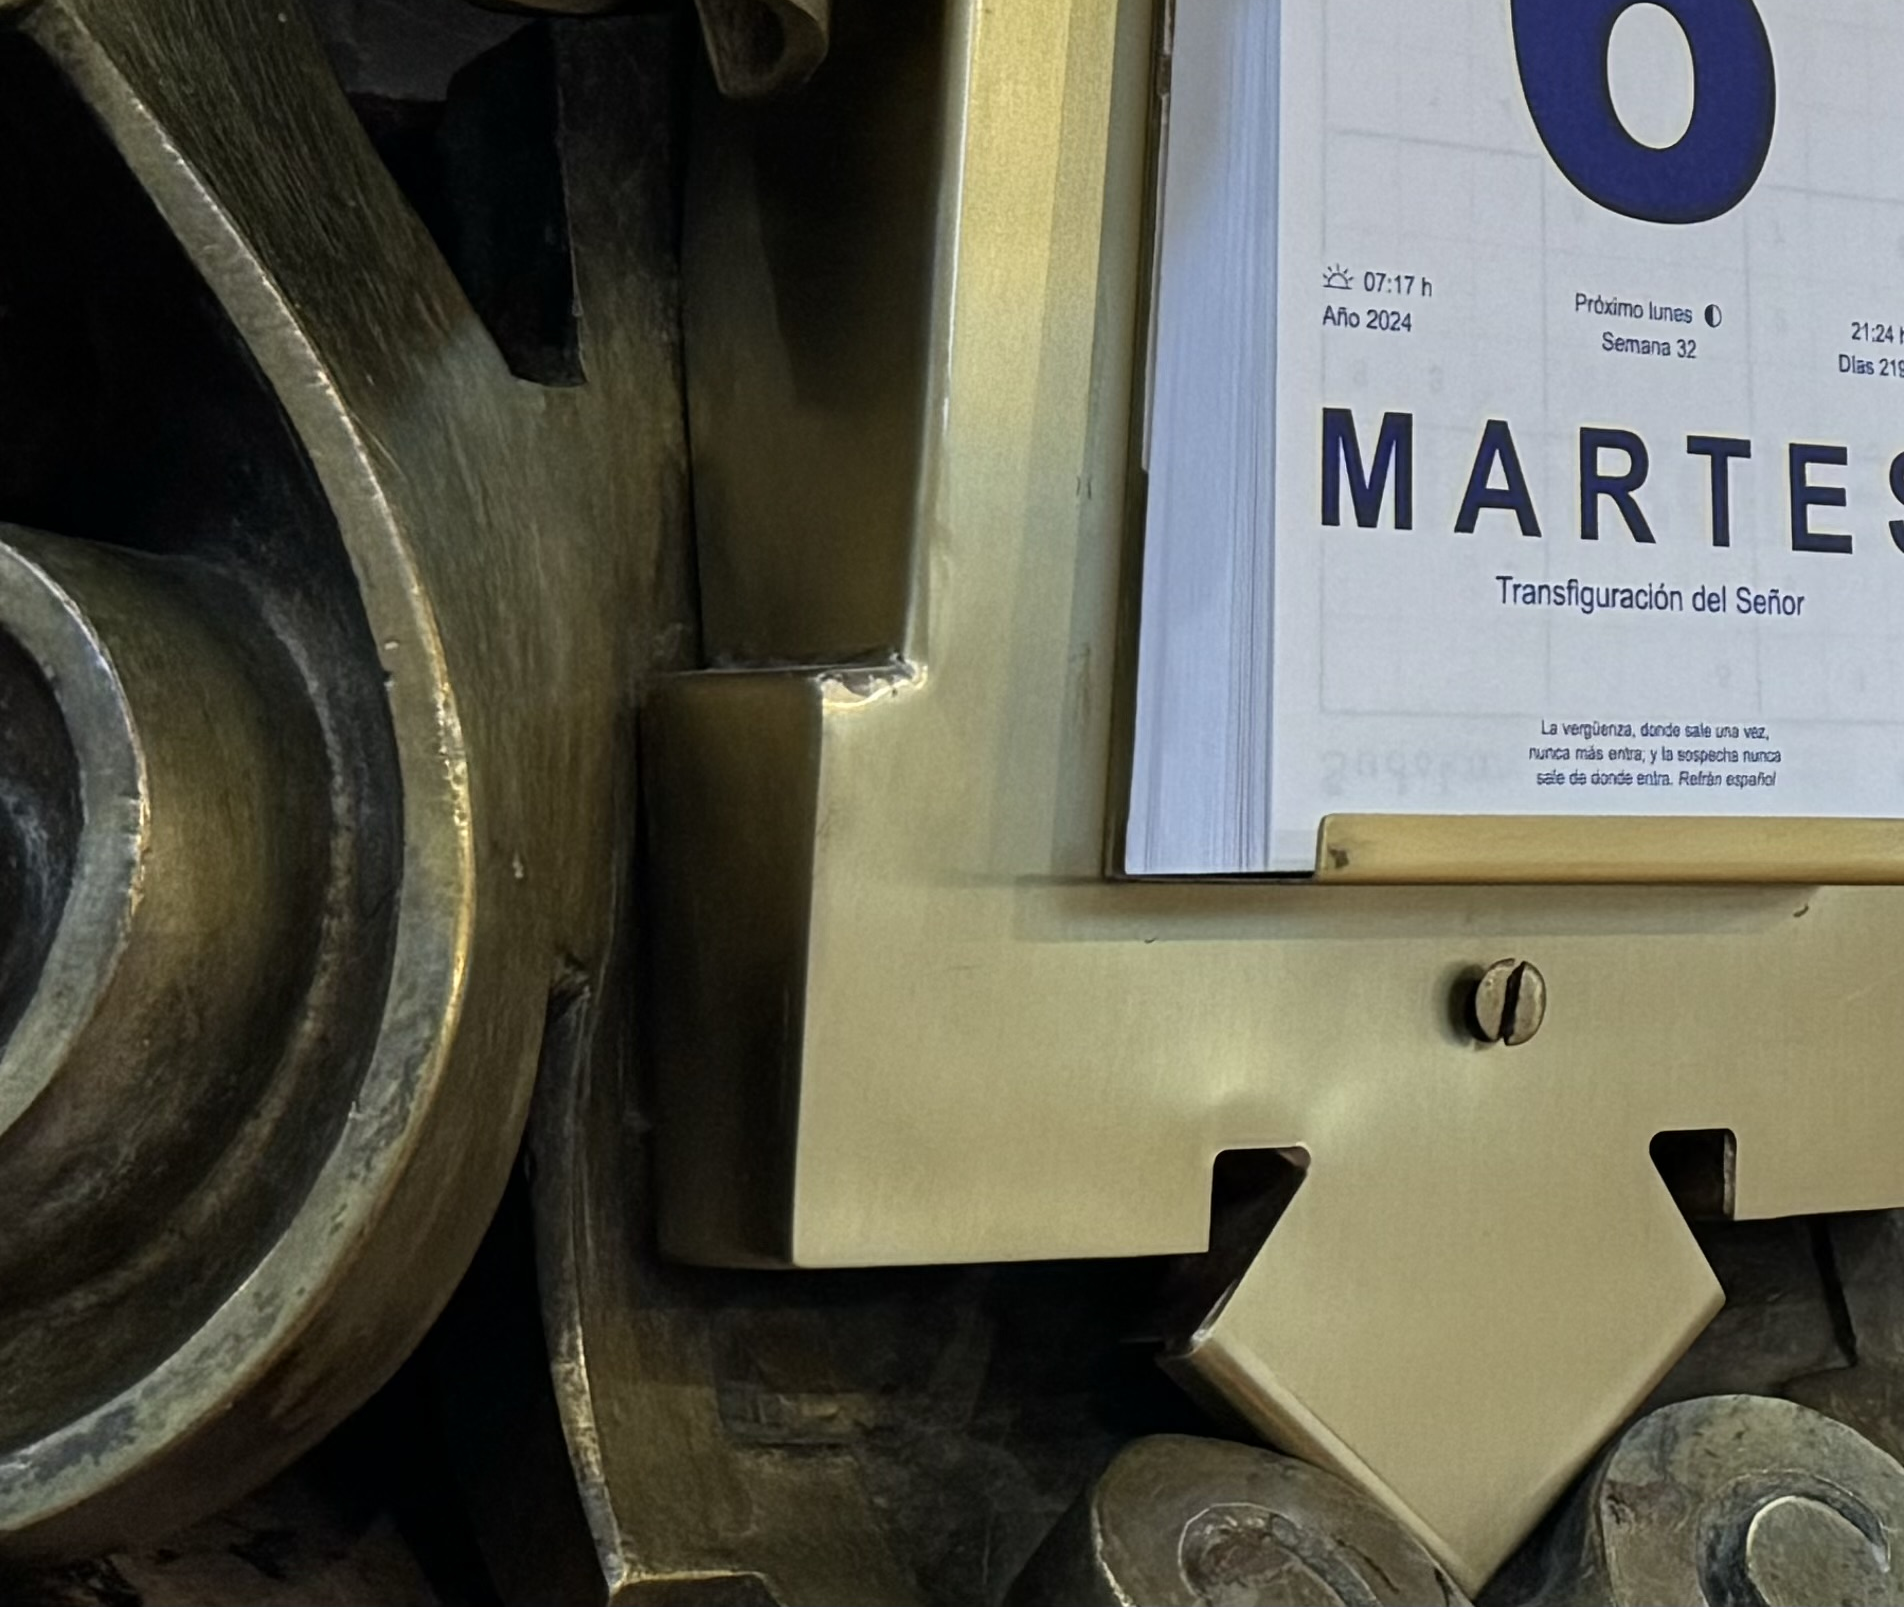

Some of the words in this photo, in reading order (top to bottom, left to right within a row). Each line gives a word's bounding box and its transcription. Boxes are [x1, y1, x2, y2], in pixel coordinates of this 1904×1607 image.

[1363, 271, 1416, 295] 07:17
[1422, 276, 1432, 297] h
[1322, 305, 1360, 328] Año
[1366, 309, 1413, 332] 2024
[1575, 292, 1643, 319] Próximo
[1650, 300, 1693, 324] lunes
[1601, 331, 1671, 357] Semana
[1676, 338, 1697, 359] 32
[1850, 321, 1894, 344] 21:24
[1496, 575, 1683, 614] Transfiguración
[1692, 584, 1726, 613] del
[1735, 586, 1805, 616] Señor
[1541, 720, 1557, 735] La
[1640, 721, 1681, 738] donde
[1684, 721, 1712, 738] sale
[1715, 725, 1739, 739] una
[1743, 726, 1770, 741] vez,
[1528, 746, 1570, 761] nunca
[1575, 744, 1604, 761] más
[1650, 748, 1658, 765] y
[1662, 745, 1673, 761] la
[1677, 746, 1739, 764] sospecha
[1743, 749, 1782, 764] nunca
[1536, 769, 1565, 786] sale
[1569, 769, 1587, 786] de
[1591, 769, 1633, 786] donde
[1726, 770, 1777, 790] español
